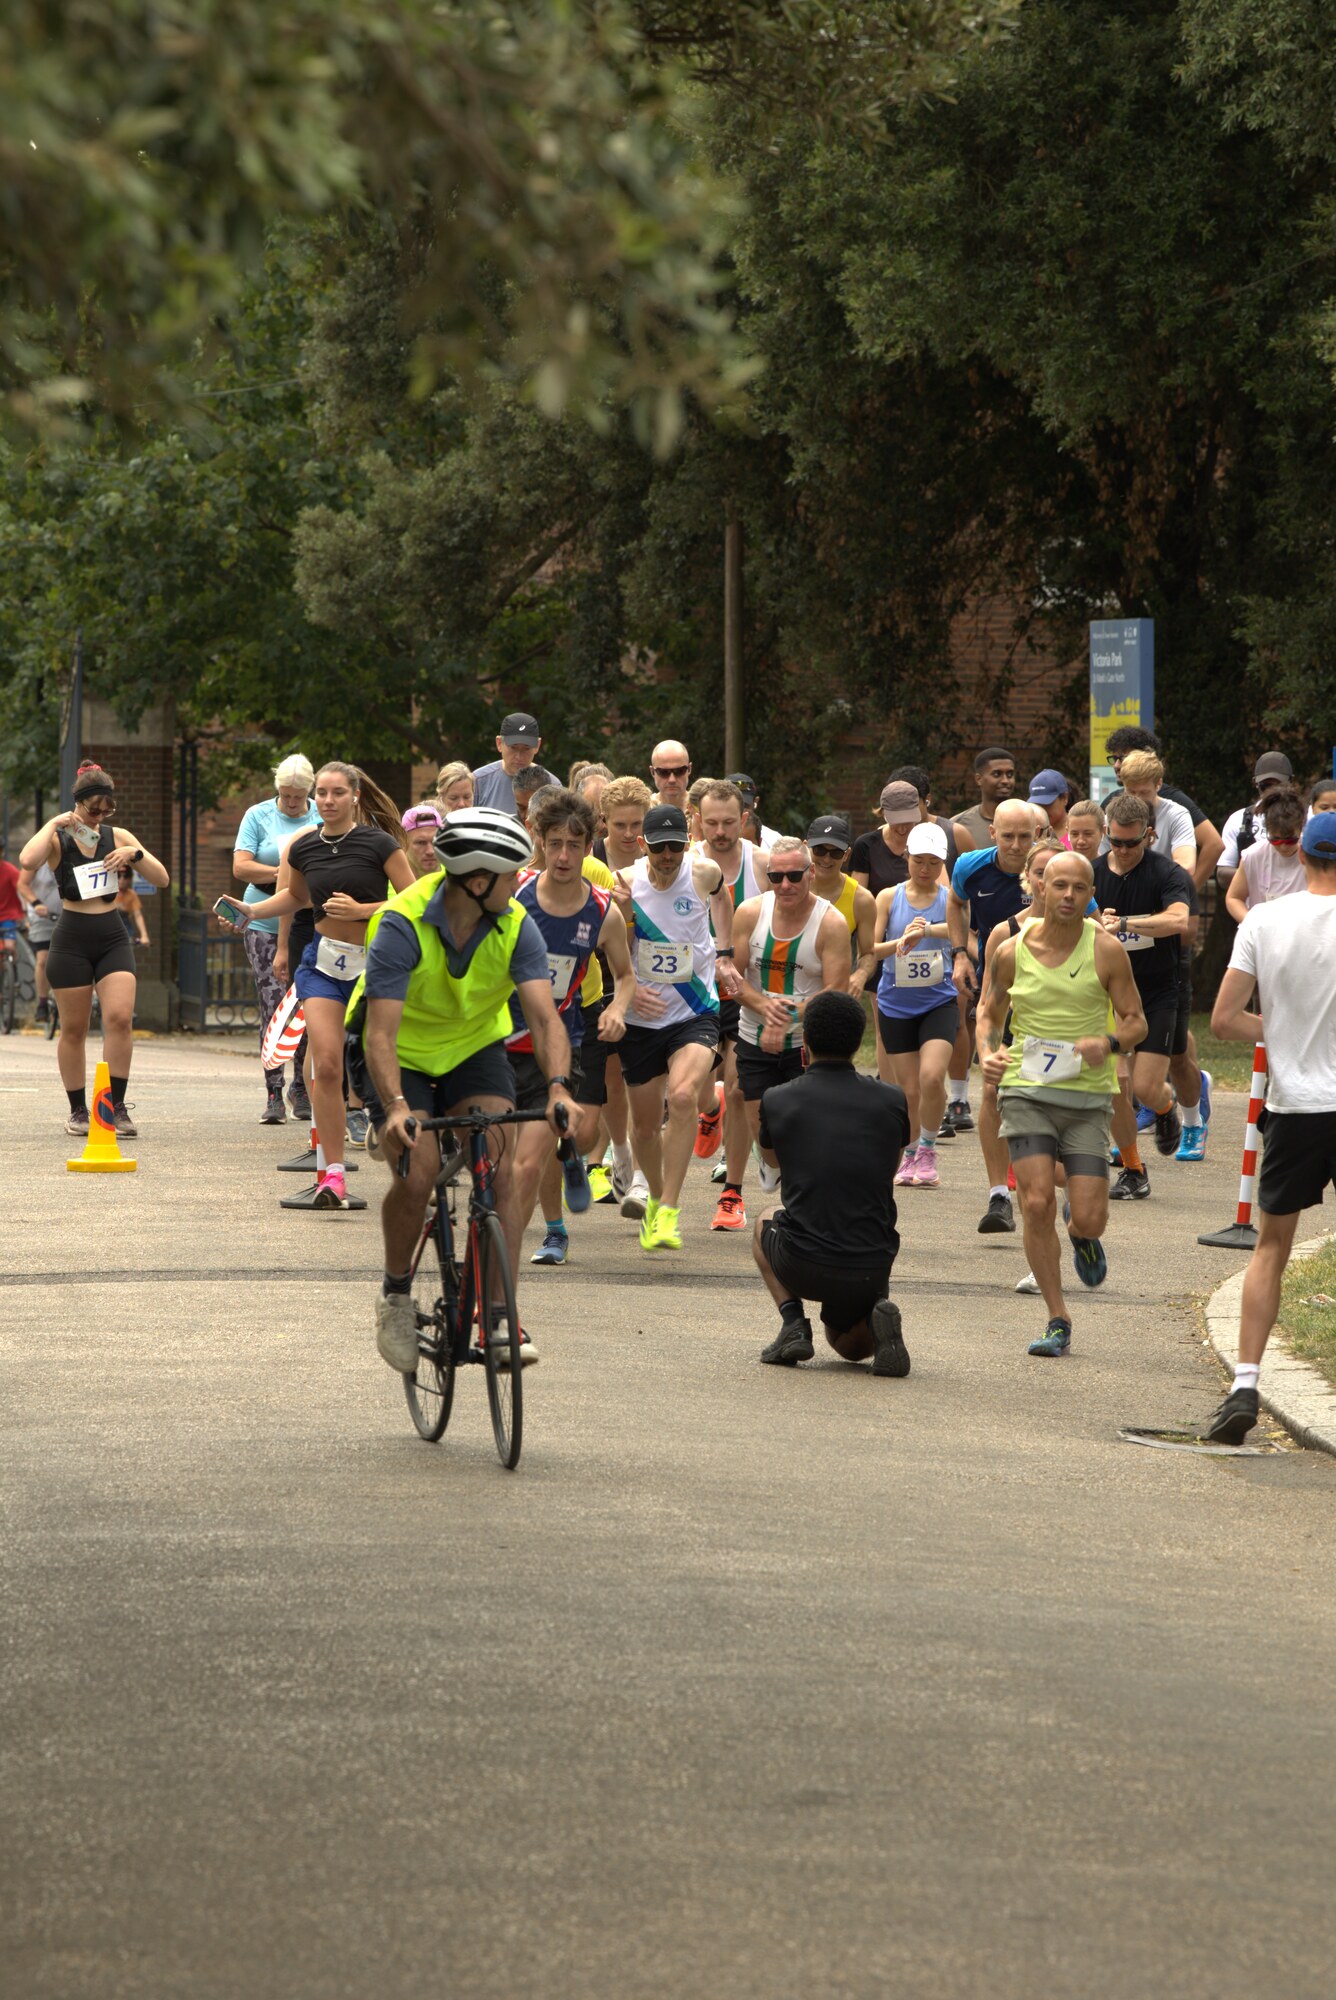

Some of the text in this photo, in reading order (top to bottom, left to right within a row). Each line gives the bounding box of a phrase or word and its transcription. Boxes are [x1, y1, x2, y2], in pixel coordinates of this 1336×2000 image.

[1093, 651, 1122, 667] Victoria Park
[88, 871, 108, 889] 77
[1116, 930, 1140, 943] 64
[334, 954, 347, 971] 4
[651, 954, 678, 974] 23
[907, 961, 931, 979] 38
[1043, 1052, 1057, 1073] 7
